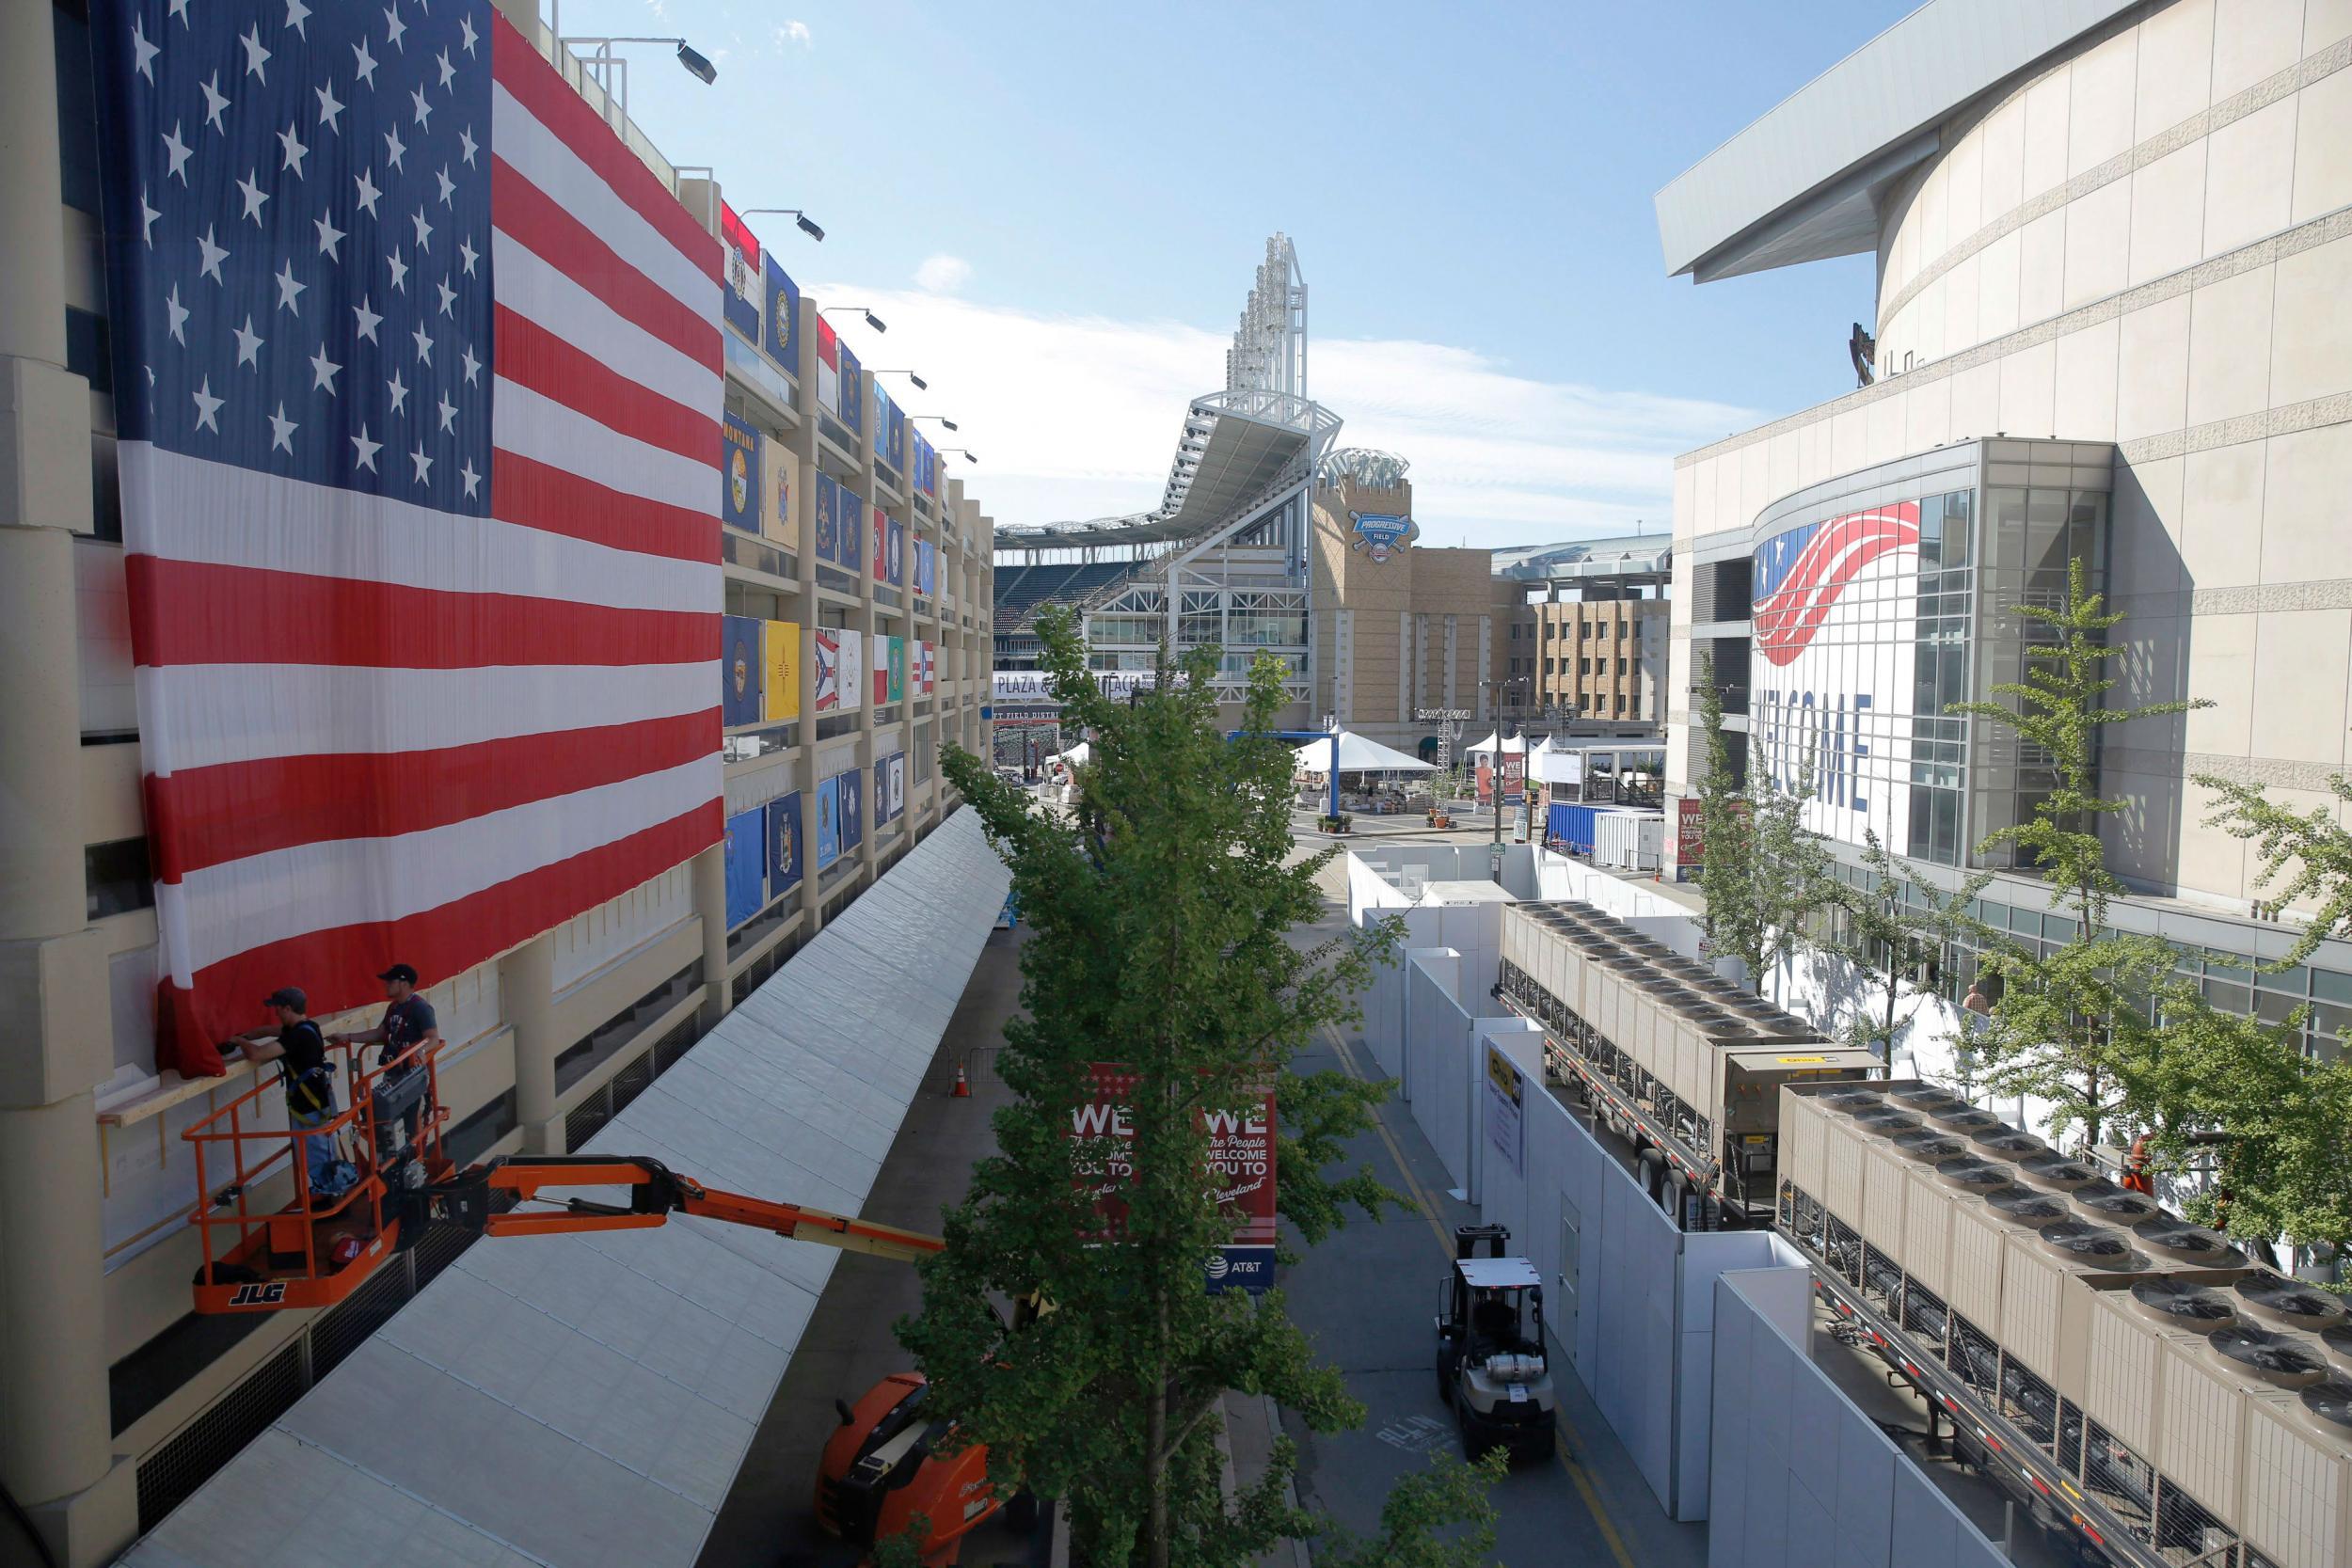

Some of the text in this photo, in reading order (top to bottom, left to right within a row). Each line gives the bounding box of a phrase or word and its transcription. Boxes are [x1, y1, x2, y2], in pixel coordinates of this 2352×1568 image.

[1361, 520, 1406, 531] PROGRESSIVE
[998, 675, 1037, 693] PLAZA
[1505, 761, 1521, 769] WE
[1681, 813, 1704, 825] WE
[1071, 1103, 1134, 1135] WE
[1202, 1103, 1267, 1133] WE
[1227, 1134, 1266, 1149] People
[1108, 1163, 1133, 1177] TO
[1204, 1162, 1267, 1175] YOU TO
[1232, 1261, 1263, 1273] AT&T
[229, 1282, 287, 1306] JLG
